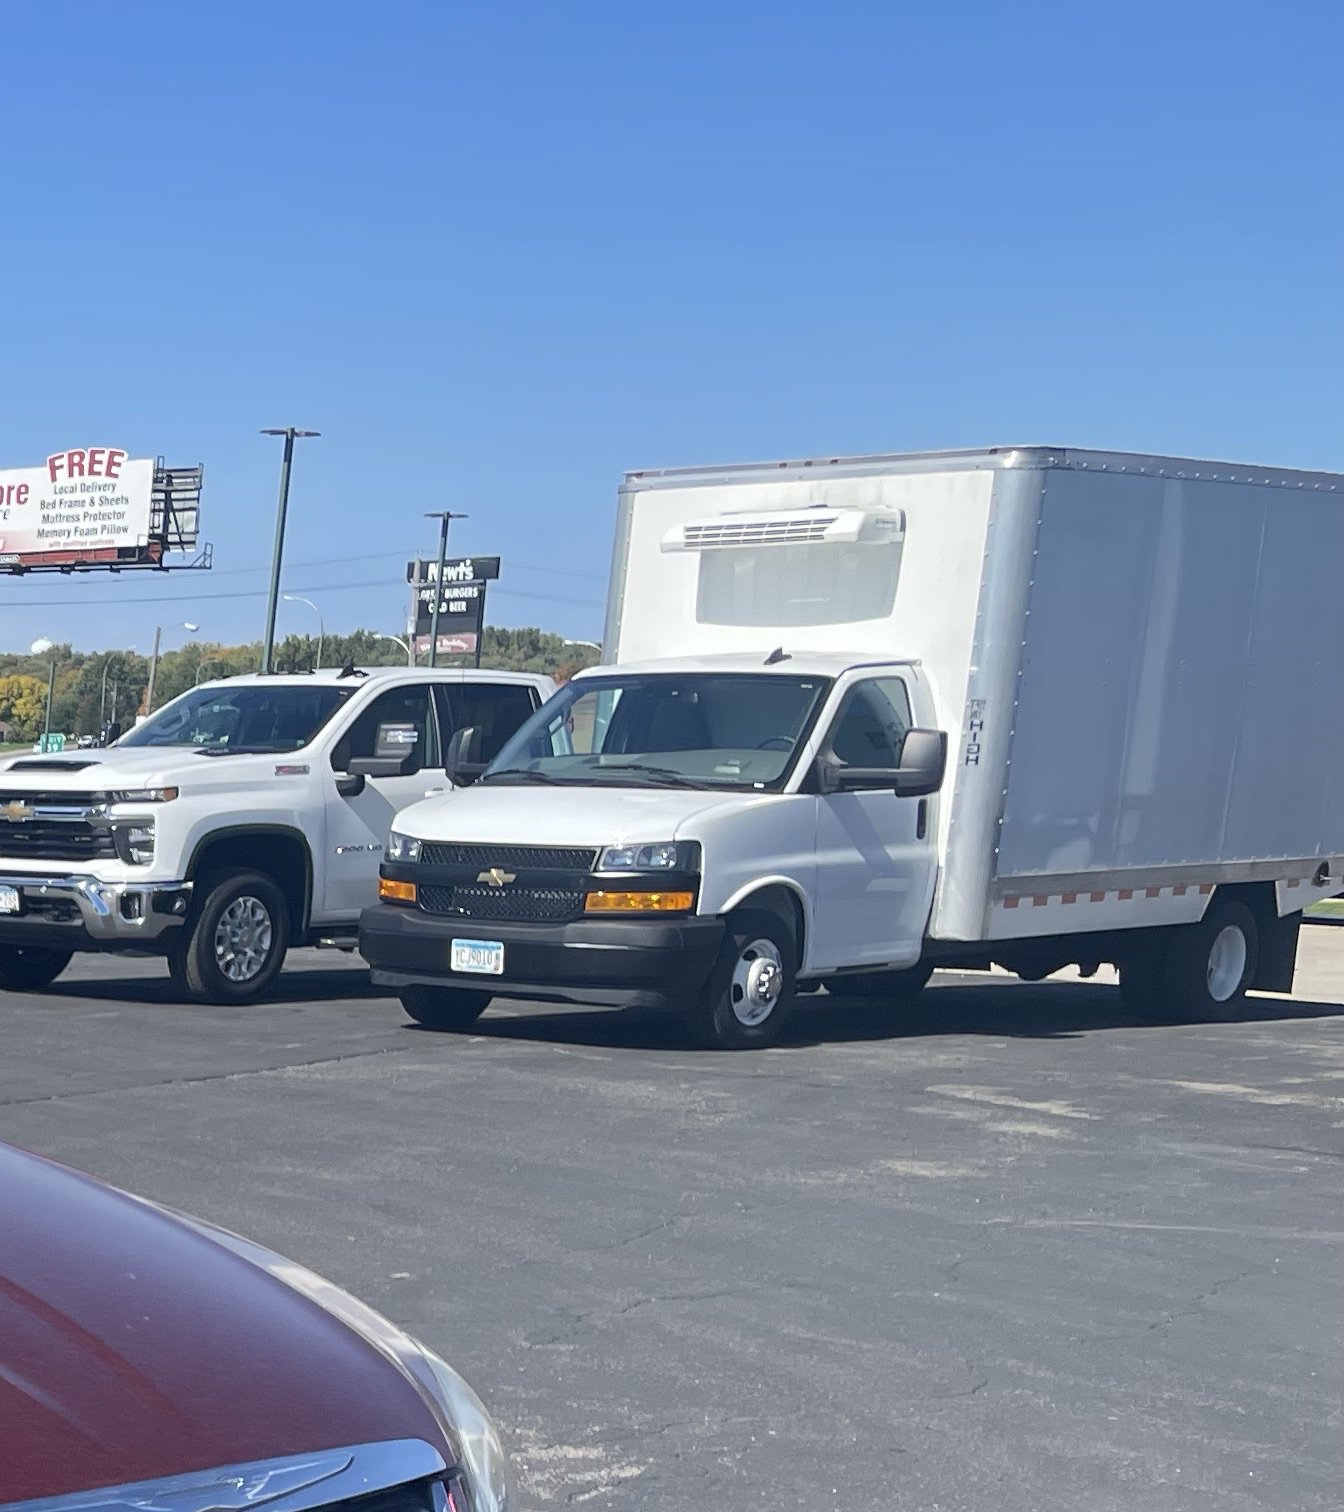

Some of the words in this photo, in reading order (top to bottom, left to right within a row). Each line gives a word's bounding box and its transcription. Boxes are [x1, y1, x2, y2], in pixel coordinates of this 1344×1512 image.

[48, 449, 125, 483] FREE
[53, 483, 77, 495] Local
[80, 481, 117, 494] Delivery
[40, 500, 56, 510] Bed
[59, 498, 86, 509] Frame
[89, 496, 95, 508] &
[98, 495, 129, 507] Sheets
[41, 513, 80, 525] Mattress
[83, 510, 126, 523] Protector
[36, 527, 71, 539] Memory
[74, 525, 98, 537] Foam
[100, 524, 129, 535] Pillow
[420, 588, 444, 601] GRE
[444, 587, 478, 599] BURGERS
[428, 601, 447, 613] CD
[449, 601, 467, 612] BEER
